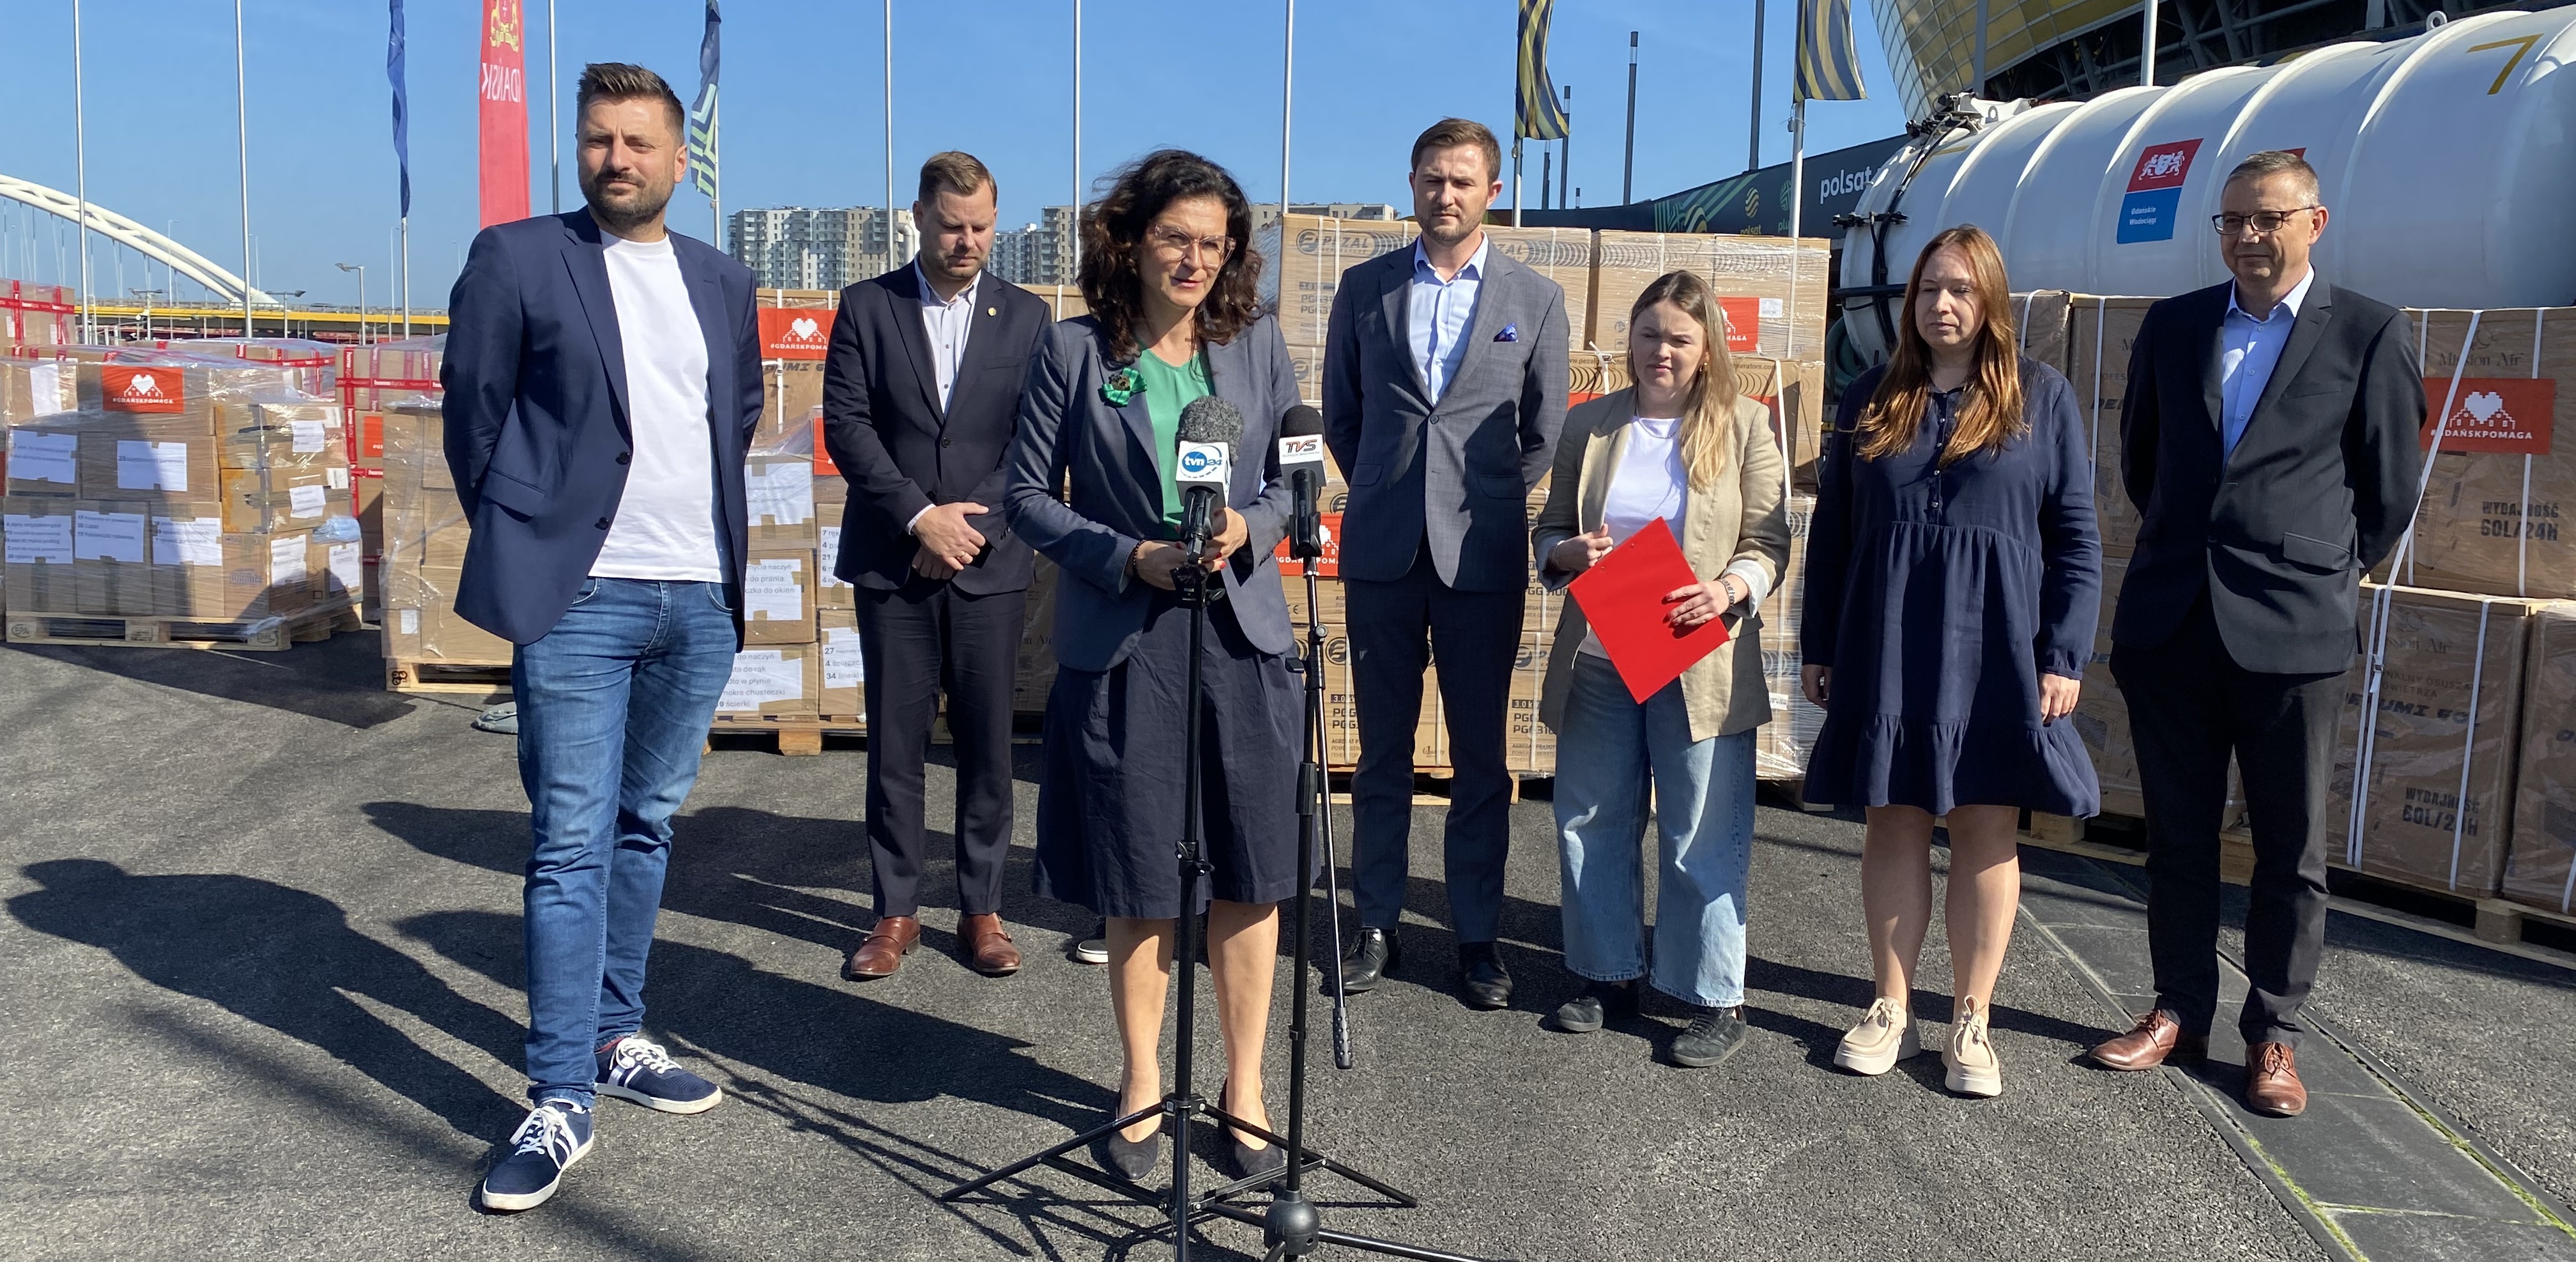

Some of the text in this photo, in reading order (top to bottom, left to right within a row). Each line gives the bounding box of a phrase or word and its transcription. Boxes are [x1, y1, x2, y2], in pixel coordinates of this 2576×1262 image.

[2465, 33, 2545, 96] 7
[1819, 165, 1871, 204] polsat
[2131, 206, 2156, 215] Gdańskie
[2497, 353, 2521, 366] Air
[2431, 429, 2533, 439] #DAŃSKPOMAGA
[1285, 439, 1317, 453] TVS
[2403, 804, 2478, 837] 60L/2H
